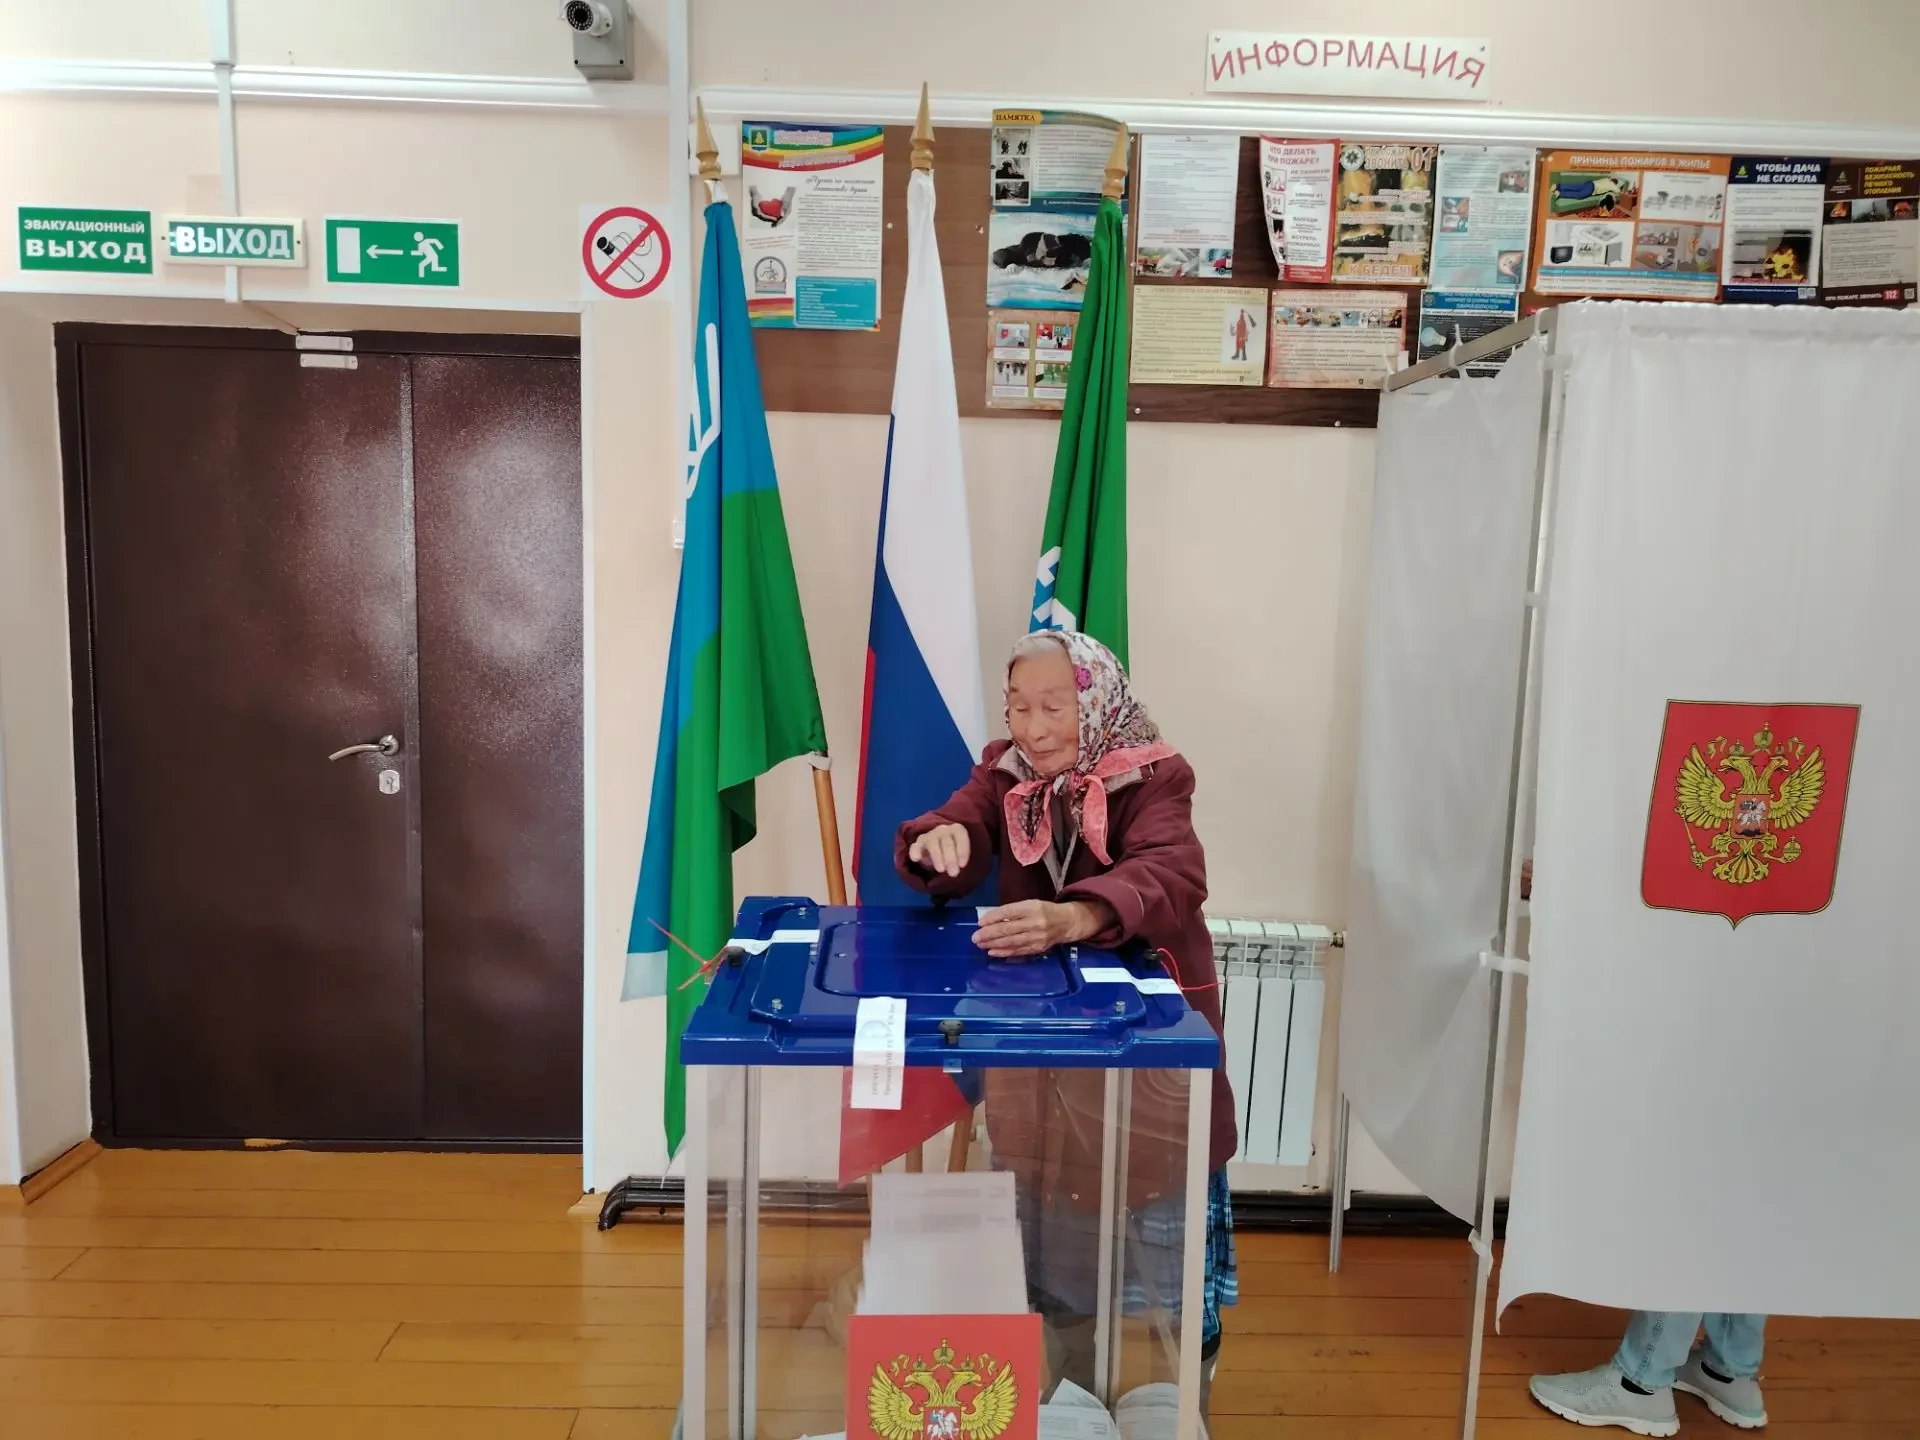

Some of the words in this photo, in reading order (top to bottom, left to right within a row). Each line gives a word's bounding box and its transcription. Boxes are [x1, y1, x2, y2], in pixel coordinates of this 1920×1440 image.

[1211, 38, 1486, 88] ИНФОРМАЦИЯ
[1283, 148, 1316, 156] ДЕЛАТЬ
[1280, 157, 1320, 165] ПОЖАРЕ?
[1411, 147, 1432, 171] 01
[1570, 155, 1618, 165] ПРИЧИНЫ
[1620, 157, 1668, 166] ПОЖАРОВ
[1756, 163, 1791, 172] ЧТОБЫ
[1792, 164, 1820, 173] ДАЧА
[1757, 174, 1771, 183] НЕ
[1773, 174, 1817, 183] СГОРЕЛА
[24, 219, 145, 234] ЭВАКУАЦИОННЫЙ
[176, 226, 290, 259] ВЫХОД
[26, 239, 146, 264] ВЫХОД
[1885, 289, 1897, 300] 112
